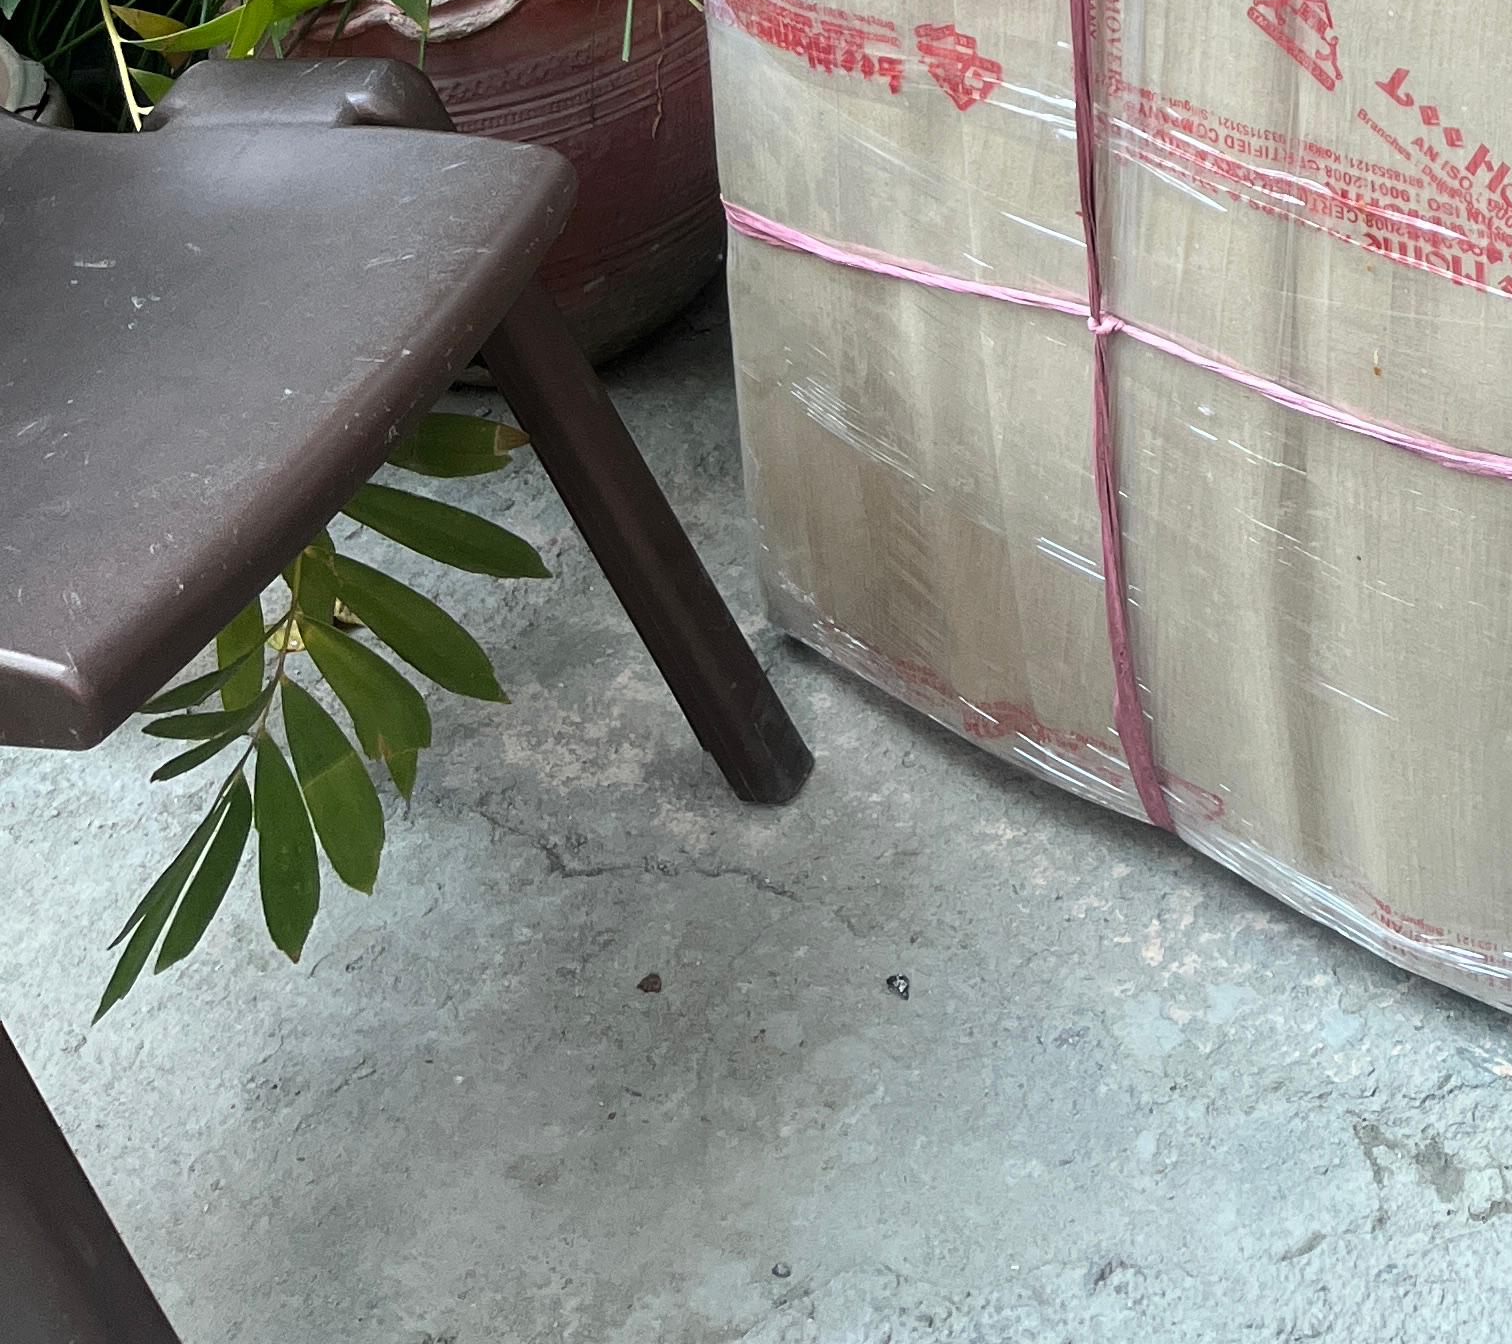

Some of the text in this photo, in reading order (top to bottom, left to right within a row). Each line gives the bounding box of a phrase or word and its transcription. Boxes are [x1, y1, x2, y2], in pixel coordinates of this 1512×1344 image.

[1355, 107, 1413, 162] Branches
[1375, 67, 1465, 150] Lee
[1412, 137, 1440, 164] AN
[1441, 162, 1474, 193] ISO
